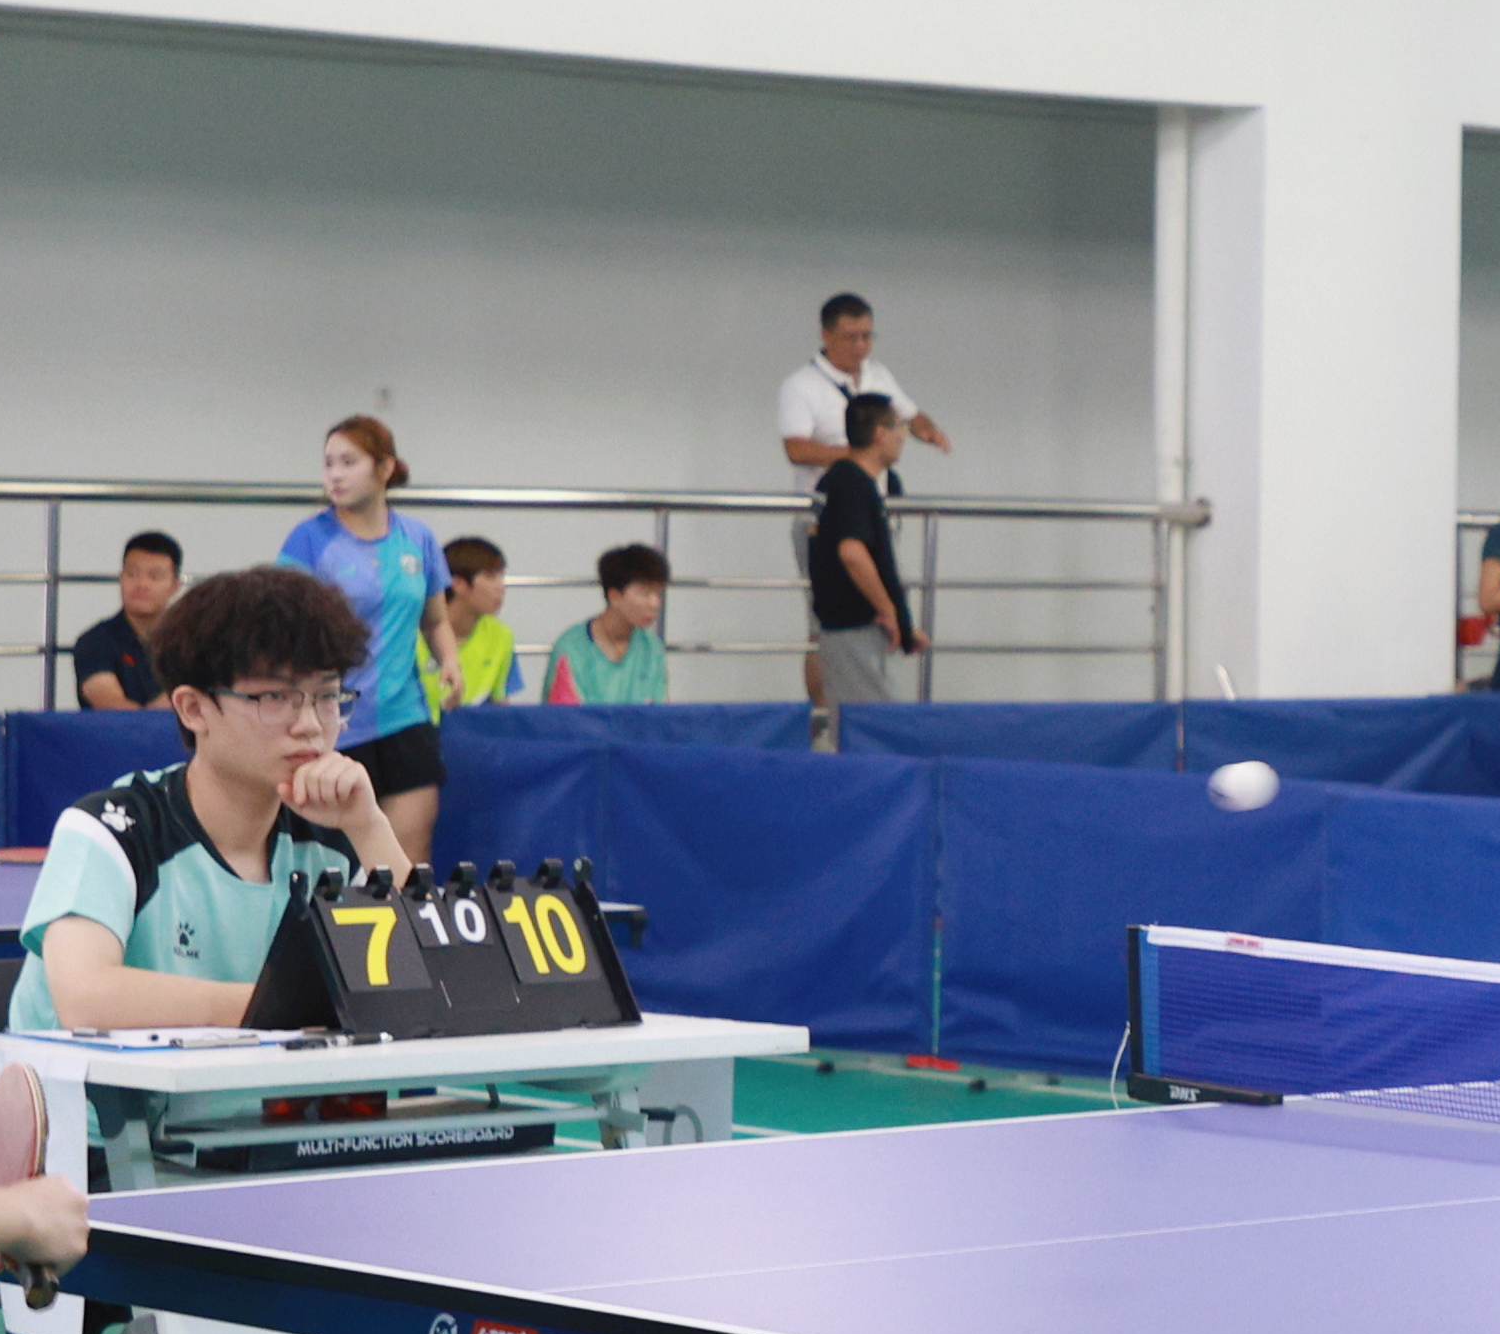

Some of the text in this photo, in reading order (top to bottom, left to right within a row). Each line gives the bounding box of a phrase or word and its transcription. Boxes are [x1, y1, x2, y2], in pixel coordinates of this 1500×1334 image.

[331, 906, 397, 985] 7
[503, 894, 586, 974] 10
[416, 1126, 514, 1147] SCOREBOARD
